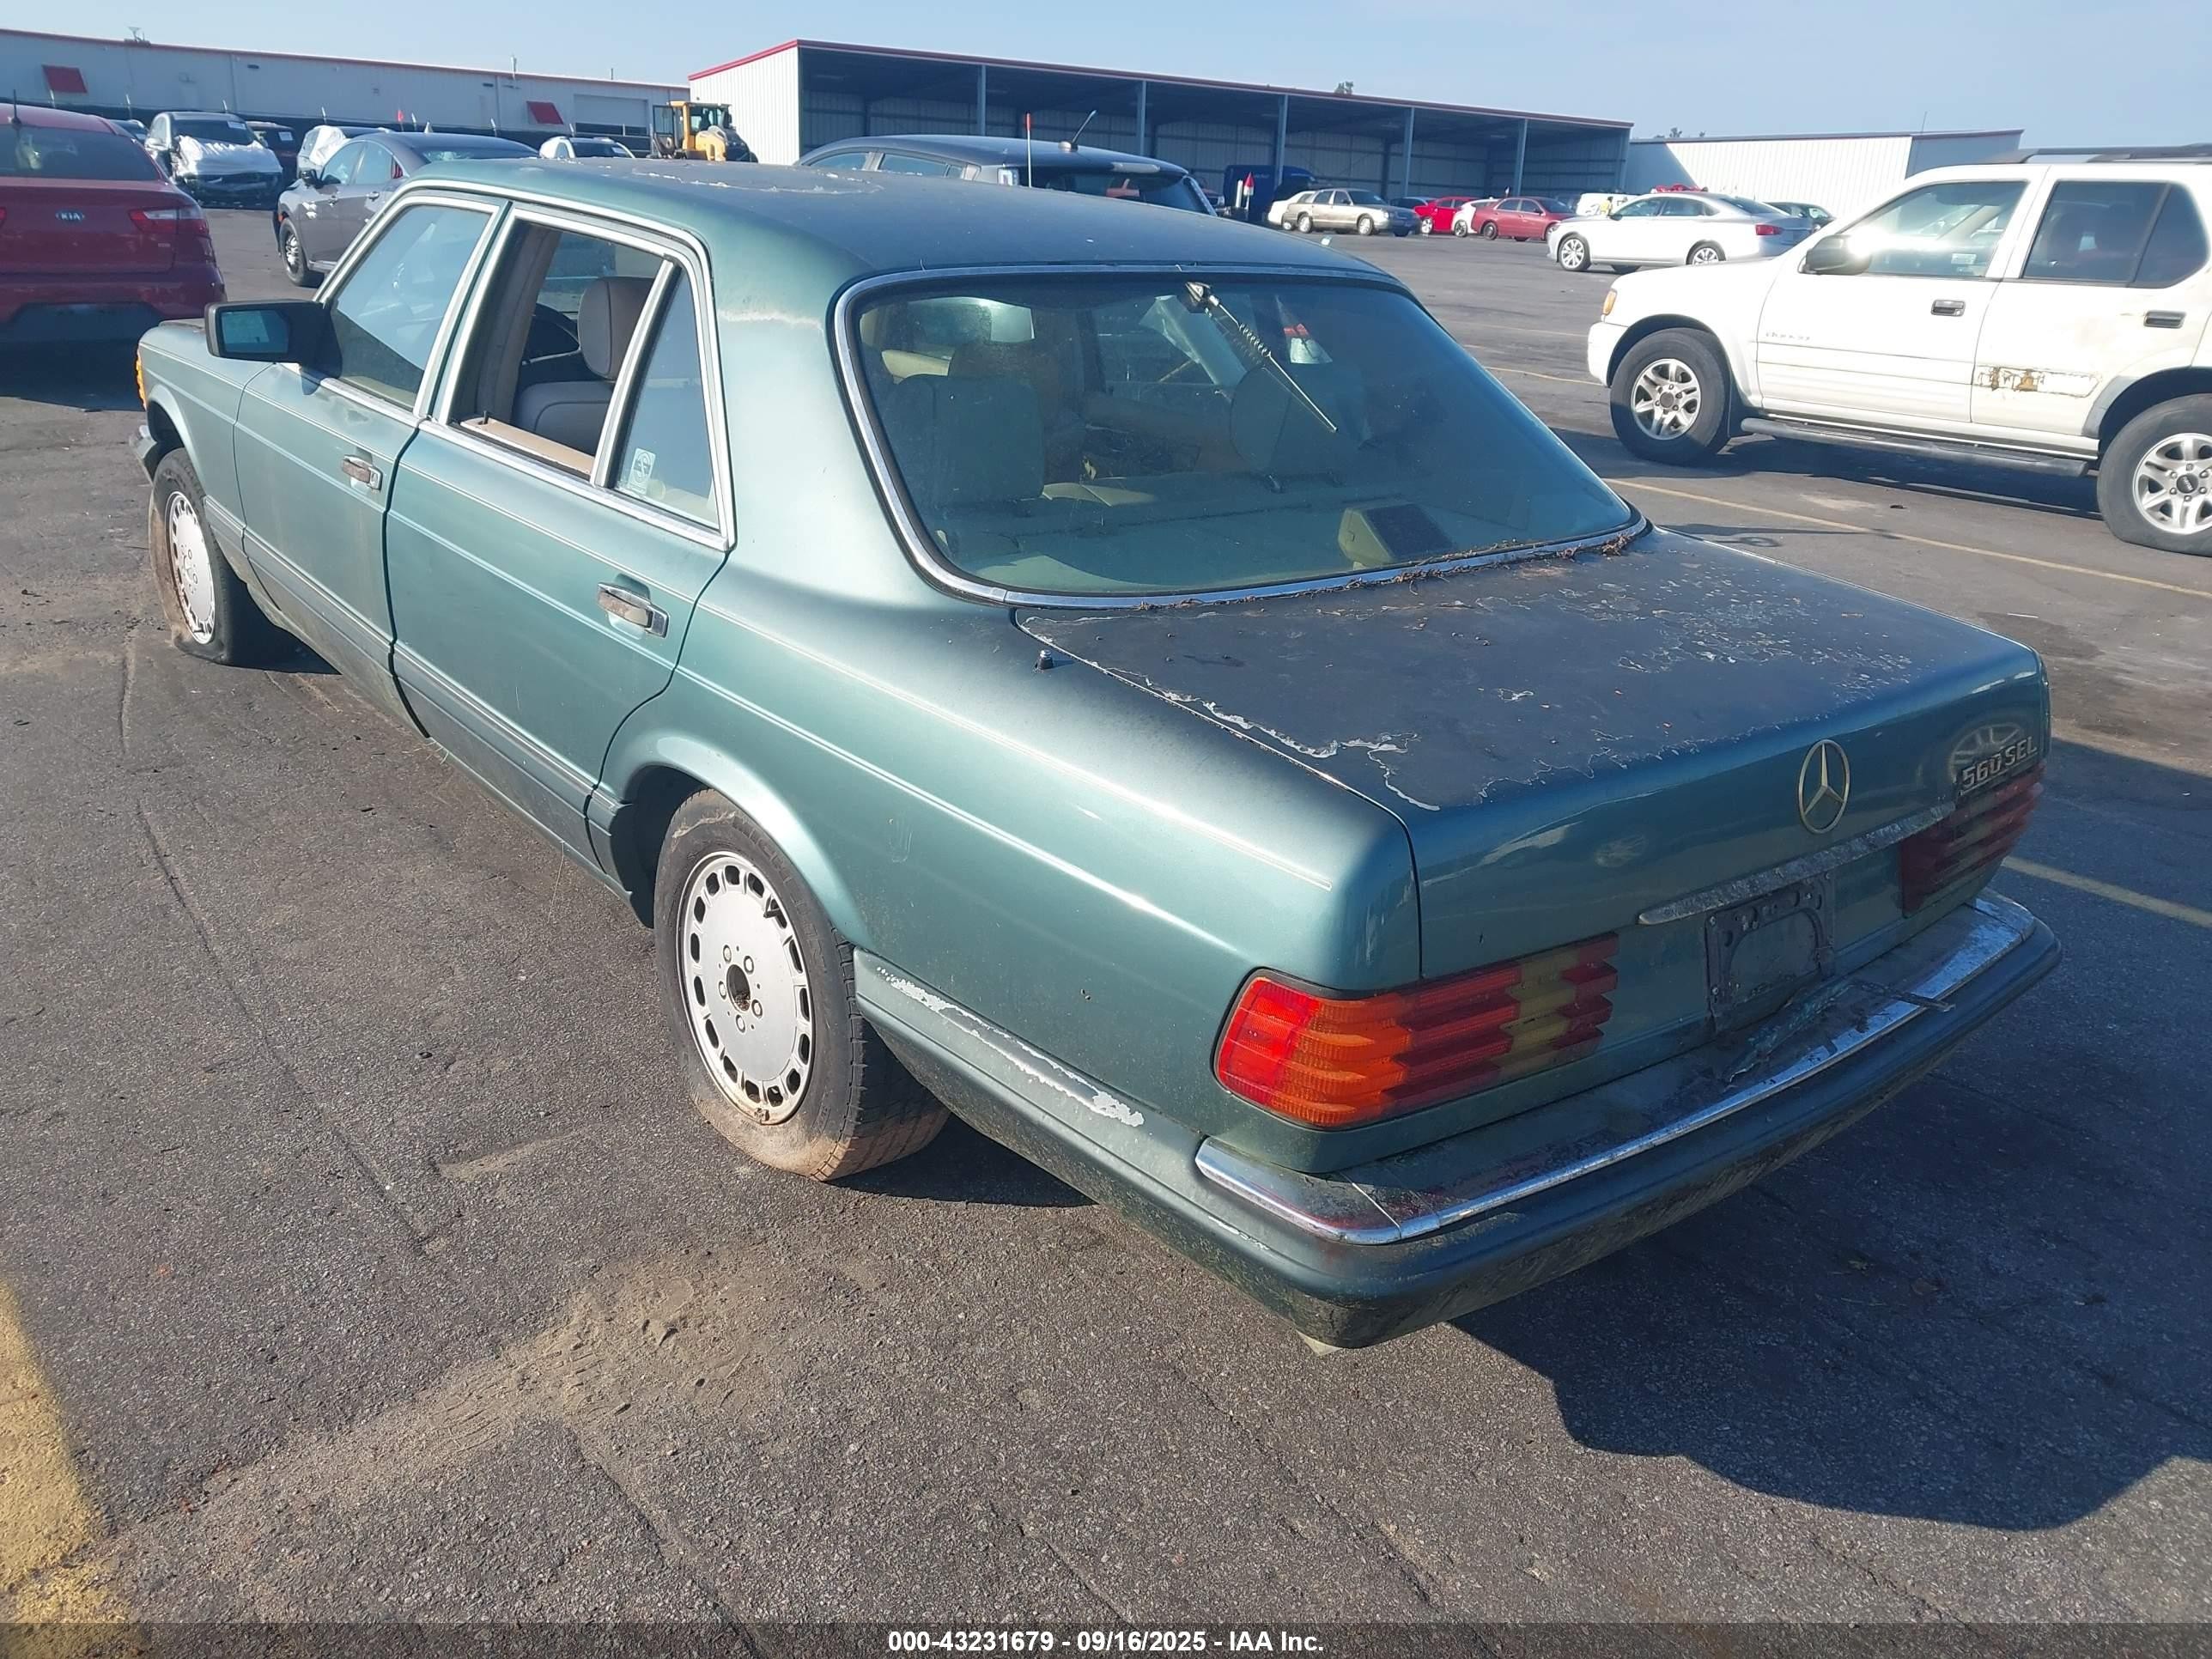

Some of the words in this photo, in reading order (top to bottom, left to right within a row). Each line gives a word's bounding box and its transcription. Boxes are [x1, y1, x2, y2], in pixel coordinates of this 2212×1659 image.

[61, 211, 82, 222] KIA
[1962, 752, 2002, 789] 560
[2005, 736, 2038, 766] SEL
